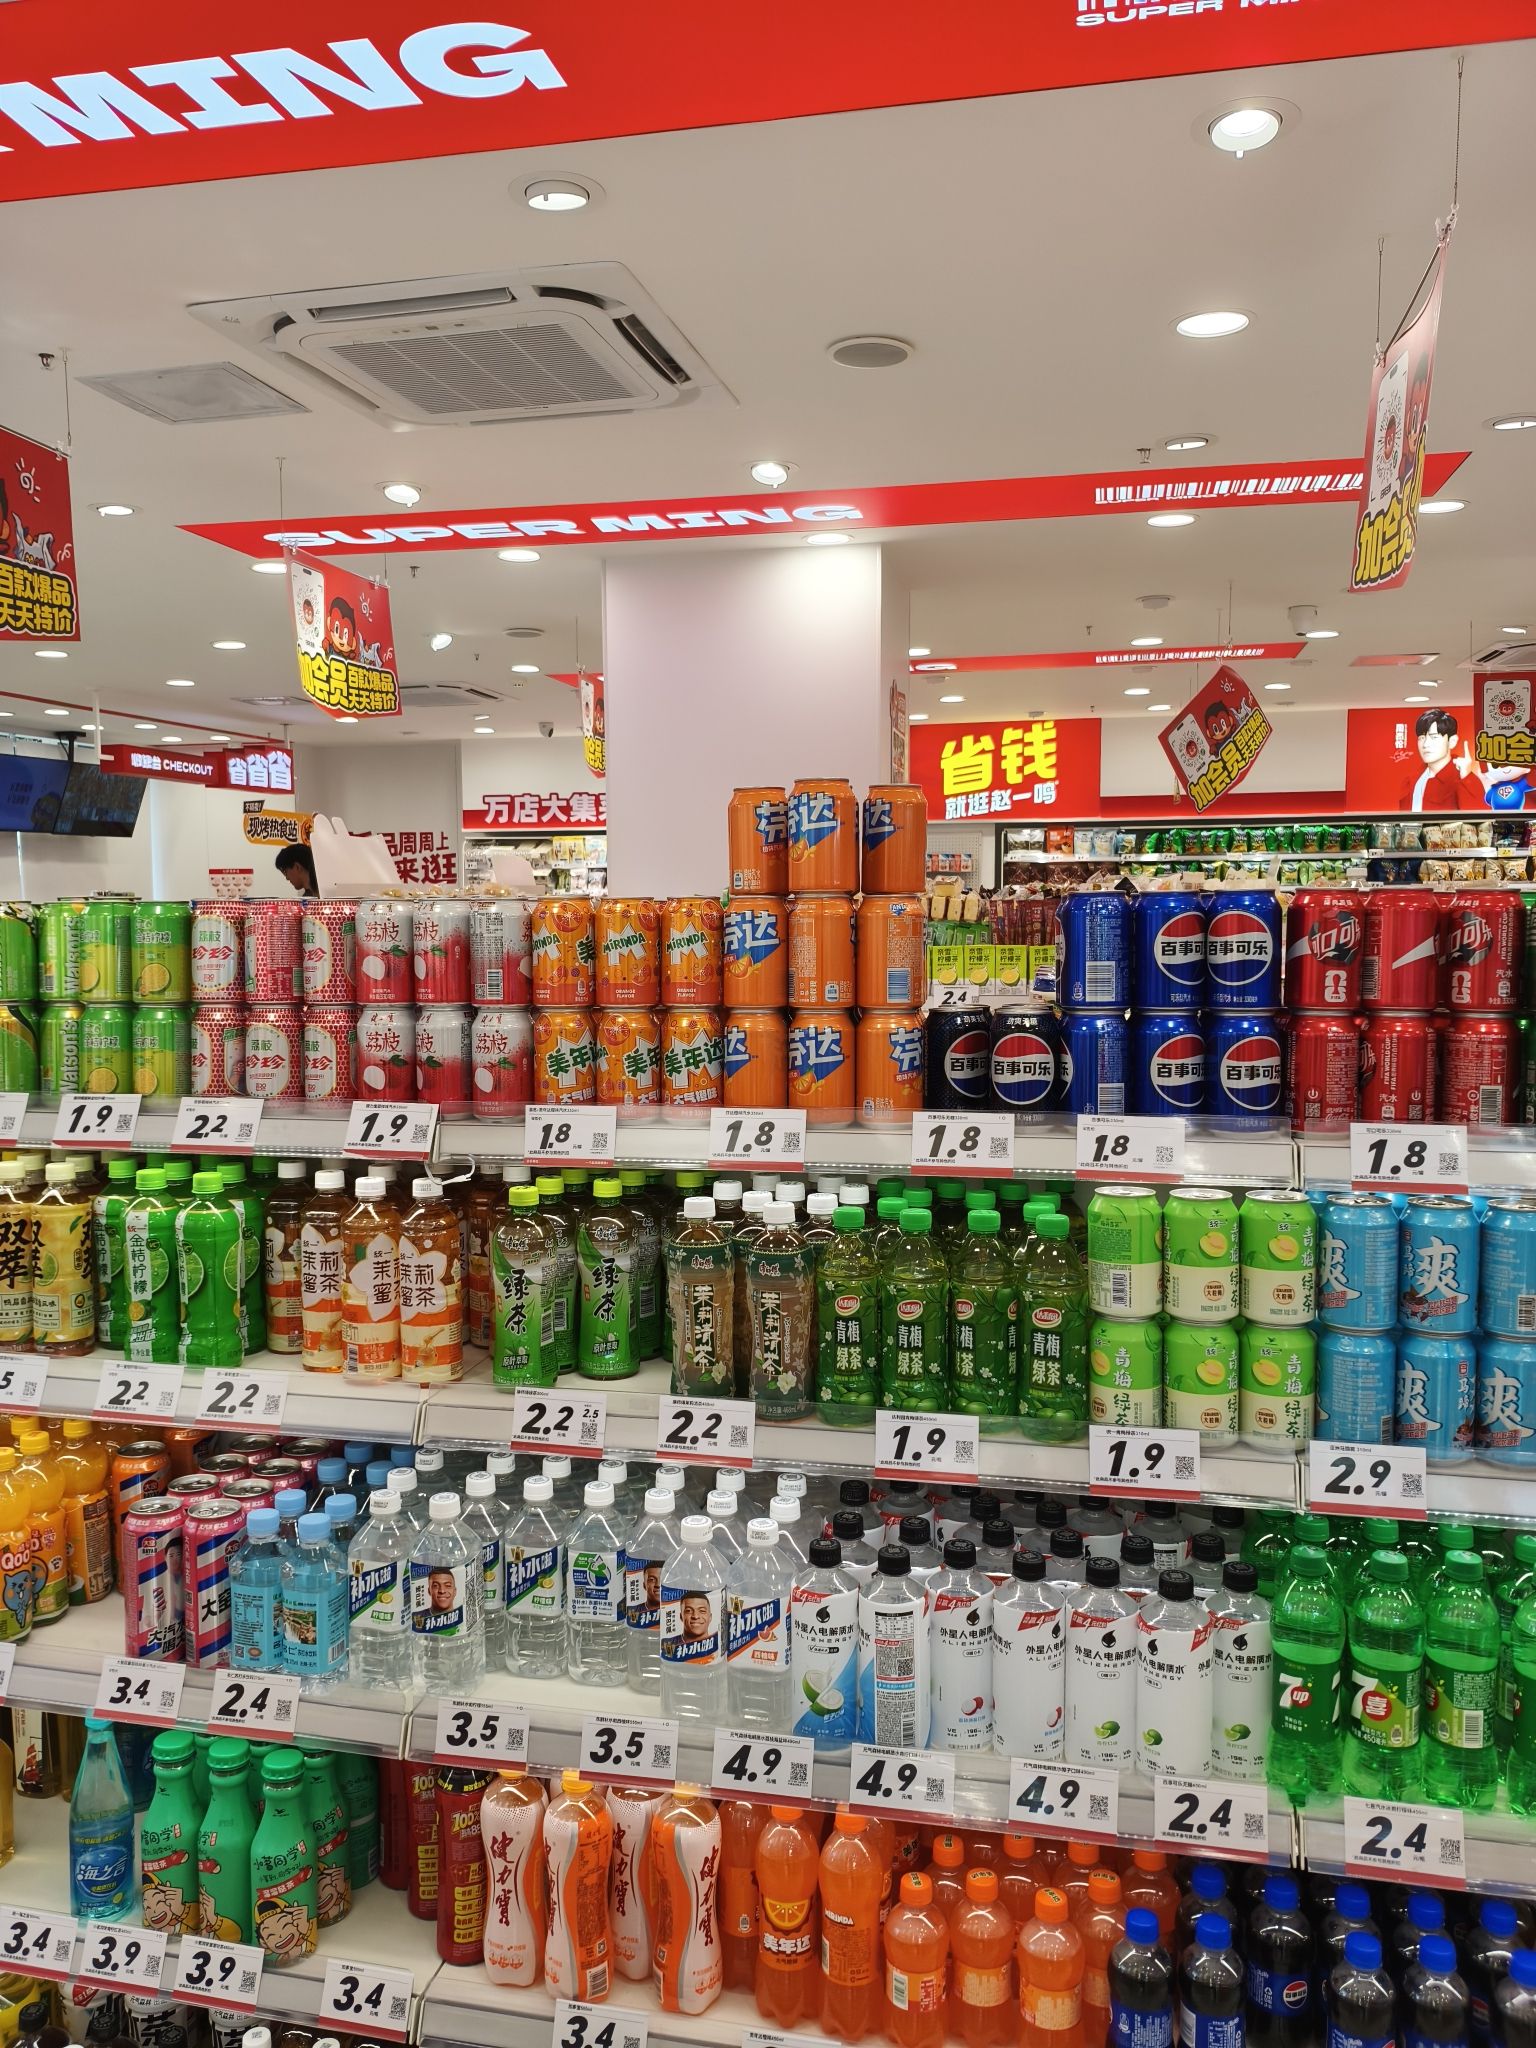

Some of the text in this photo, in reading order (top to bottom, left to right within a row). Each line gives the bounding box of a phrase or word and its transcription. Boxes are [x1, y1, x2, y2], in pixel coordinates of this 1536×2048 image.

[1076, 2, 1223, 27] SUPER
[0, 22, 567, 147] MING
[262, 505, 863, 548] SUPER MING
[163, 758, 214, 777] CHECKOUT
[228, 750, 293, 791] 省省省
[940, 721, 1057, 796] 省钱
[945, 782, 1056, 820] 就逛赵一鸣
[247, 816, 298, 843] 现烤热食站
[363, 917, 401, 942] 荔枝
[1207, 940, 1268, 956] 百事可乐
[942, 990, 967, 1005] 2.4
[365, 1028, 402, 1053] 荔枝
[475, 1029, 511, 1054] 荔枝
[994, 1060, 1051, 1076] 百事可乐
[68, 1104, 113, 1134] 1.9
[186, 1115, 228, 1140] 2.2
[359, 1113, 408, 1143] 1.9
[539, 1123, 572, 1150] 1.8
[725, 1120, 776, 1153] 1.8
[928, 1125, 982, 1159] 1.8
[1092, 1134, 1130, 1163] 1.8
[1366, 1138, 1428, 1175] 1.8
[129, 1233, 148, 1295] 金桔柠檬
[302, 1250, 339, 1272] 茉莉
[400, 1262, 434, 1285] 茉莉
[1415, 1235, 1470, 1303] 爽
[303, 1273, 341, 1294] 蜜茶
[400, 1286, 436, 1307] 蜜茶
[592, 1257, 620, 1322] 绿茶
[502, 1268, 529, 1335] 绿茶
[691, 1284, 720, 1374] 茉莉清茶
[758, 1291, 788, 1381] 茉莉清茶
[836, 1319, 860, 1344] 青梅
[897, 1322, 923, 1349] 青梅
[1032, 1331, 1061, 1358] 青梅
[836, 1346, 862, 1371] 绿茶
[897, 1351, 924, 1376] 绿茶
[1032, 1359, 1061, 1386] 绿茶
[1114, 1347, 1133, 1387] 青梅
[1285, 1354, 1302, 1395] 青梅
[109, 1380, 149, 1406] 2.2
[207, 1382, 259, 1413] 2.2
[521, 1402, 574, 1435] 2.2
[582, 1408, 599, 1419] 2.5
[666, 1410, 723, 1445] 2.2
[891, 1425, 947, 1461] 1.9
[1108, 1440, 1165, 1478] 1.9
[1324, 1456, 1392, 1495] 2.9
[351, 1565, 392, 1602] 补水啦
[509, 1549, 554, 1589] 补水啦
[424, 1612, 460, 1632] 补水啦
[729, 1601, 774, 1641] 补水啦
[794, 1618, 854, 1638] 外星人电解质水
[675, 1636, 714, 1659] 补水啦
[109, 1676, 150, 1705] 3.4
[217, 1683, 271, 1718] 2.4
[446, 1710, 500, 1748] 3.5
[589, 1727, 646, 1766] 3.5
[722, 1744, 782, 1783] 4.9
[856, 1759, 918, 1797] 4.9
[1016, 1775, 1081, 1815] 4.9
[1168, 1793, 1233, 1835] 2.4
[1360, 1815, 1428, 1859] 2.4
[77, 1855, 128, 1881] 海之言
[255, 1846, 301, 1872] 小茗同学
[3, 1921, 52, 1956] 3.4
[92, 1936, 141, 1972] 3.9
[764, 1932, 811, 1955] 美年达
[185, 1951, 236, 1987] 3.9
[332, 1975, 386, 2014] 3.4
[561, 2017, 617, 2048] 3.4
